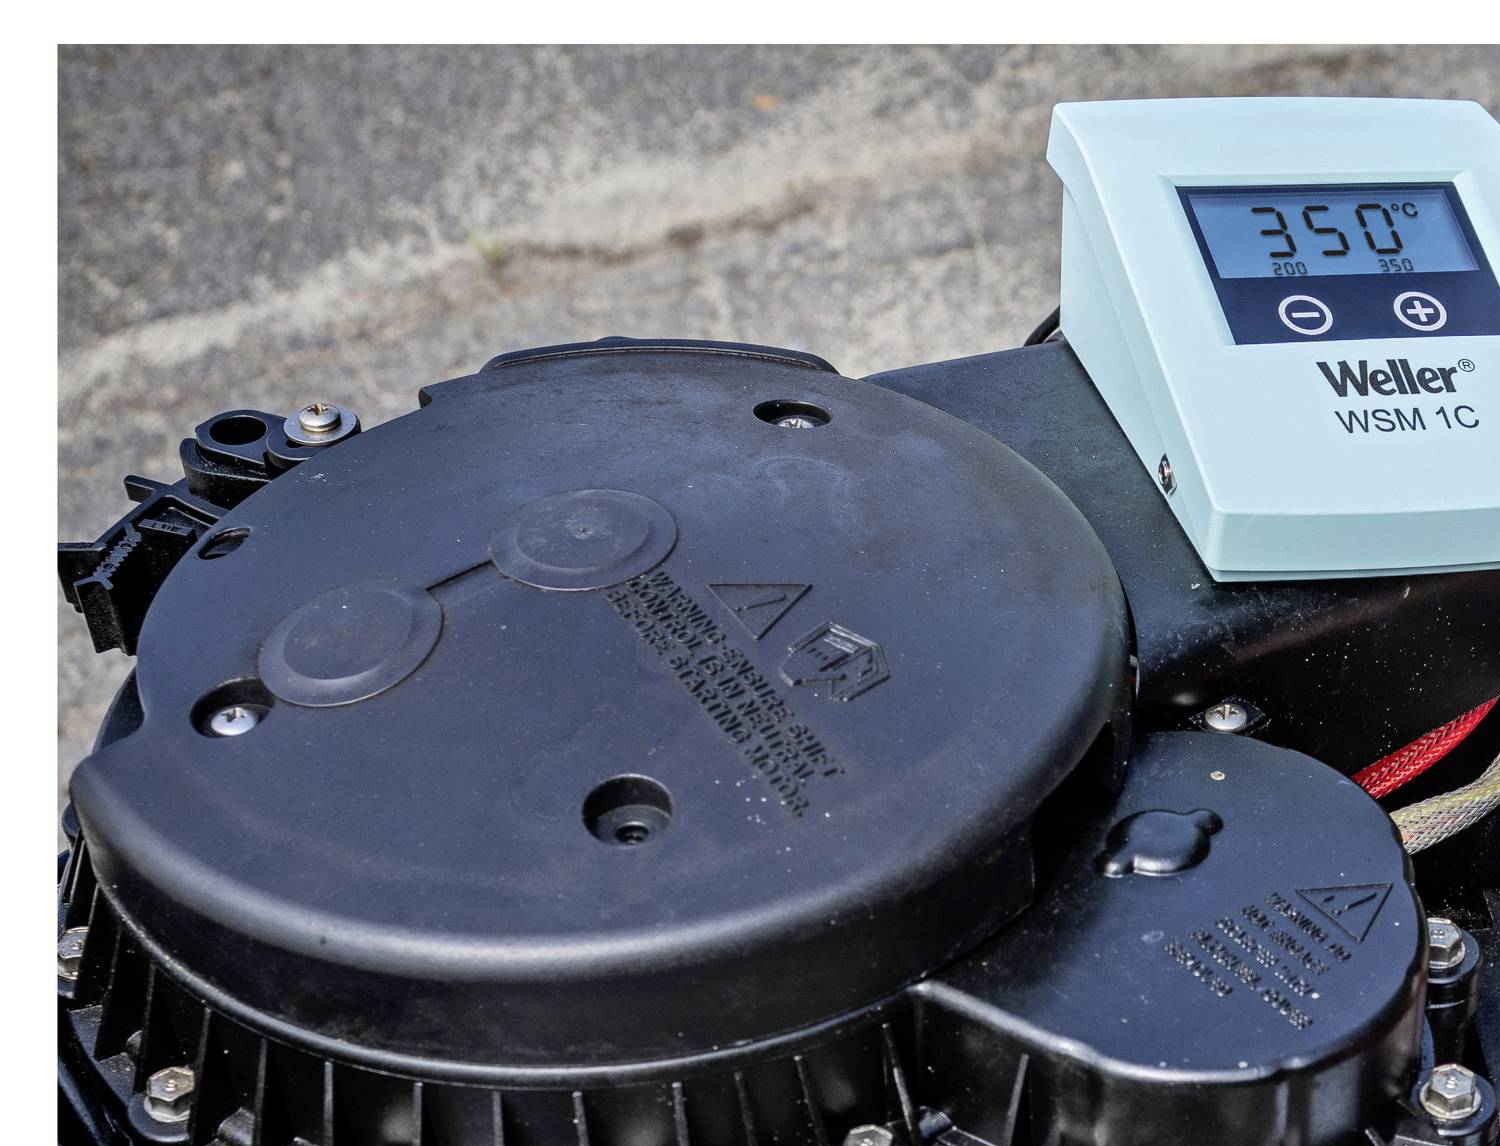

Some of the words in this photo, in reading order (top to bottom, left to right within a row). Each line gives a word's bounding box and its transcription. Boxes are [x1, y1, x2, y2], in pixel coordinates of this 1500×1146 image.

[1272, 261, 1308, 276] 200
[1378, 258, 1414, 273] 350
[1334, 407, 1427, 434] WSM
[1435, 405, 1480, 430] 1C
[606, 584, 676, 656] BEFORE
[665, 654, 753, 747] STARTING
[627, 574, 705, 656] CONTROL
[697, 652, 724, 677] IS
[716, 673, 746, 702] IN
[736, 697, 817, 786] NEUTRAL
[785, 721, 846, 780] SHIFT
